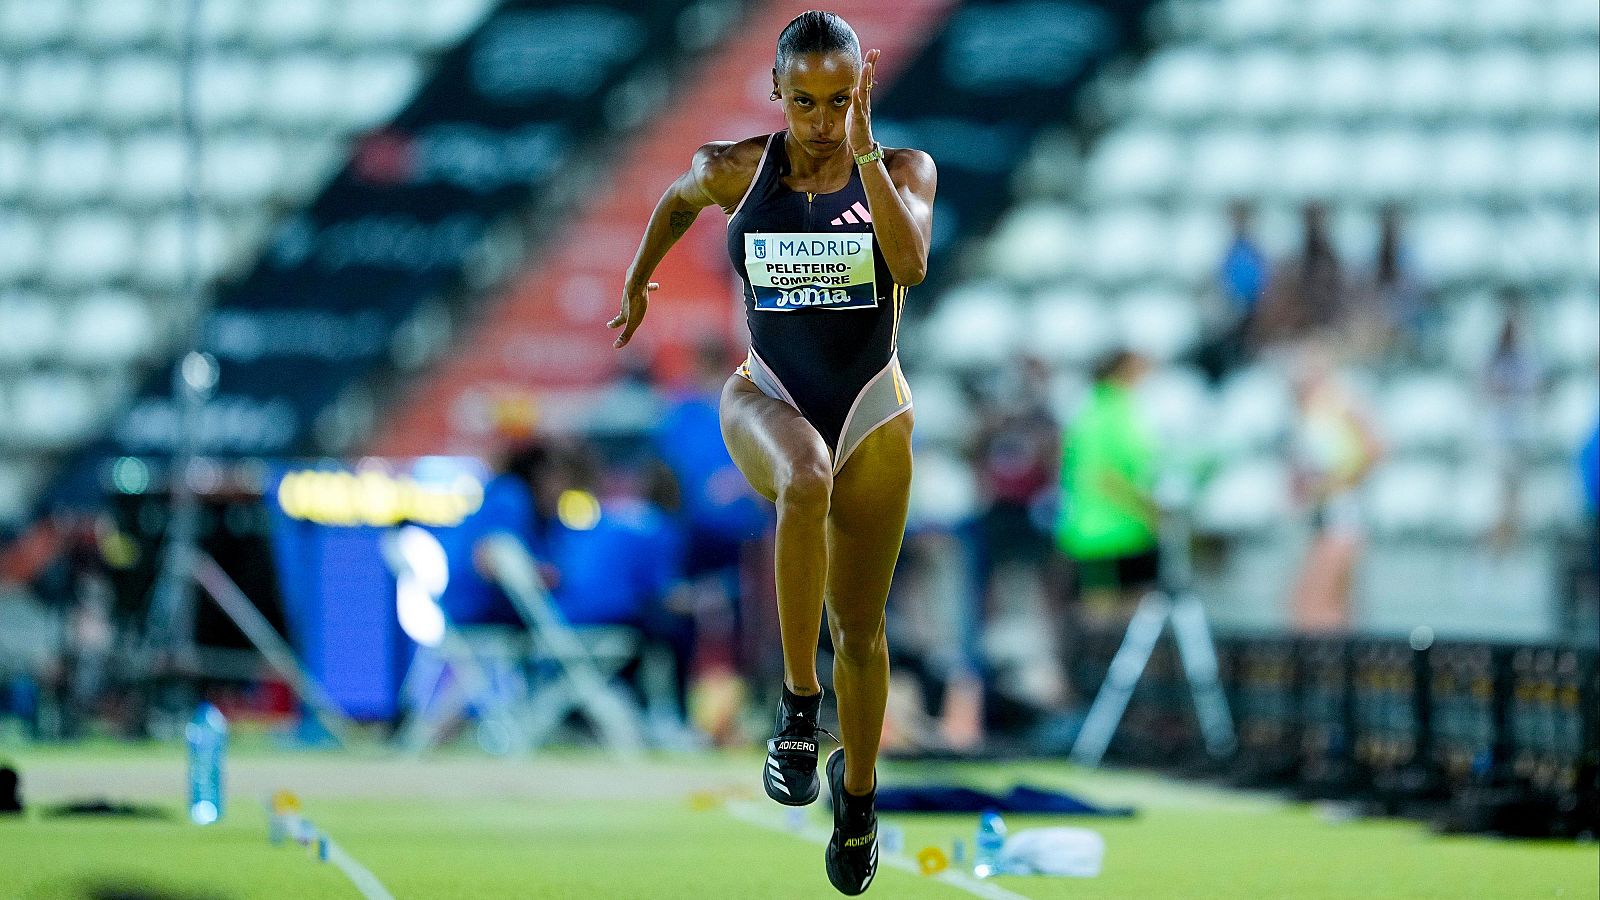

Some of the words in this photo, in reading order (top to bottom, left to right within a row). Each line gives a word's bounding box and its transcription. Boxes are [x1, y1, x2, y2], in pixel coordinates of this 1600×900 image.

[779, 240, 861, 256] MADRID
[766, 263, 852, 274] PELETEIRO-
[770, 275, 850, 286] COMPAORE
[777, 740, 815, 752] ADIZERO
